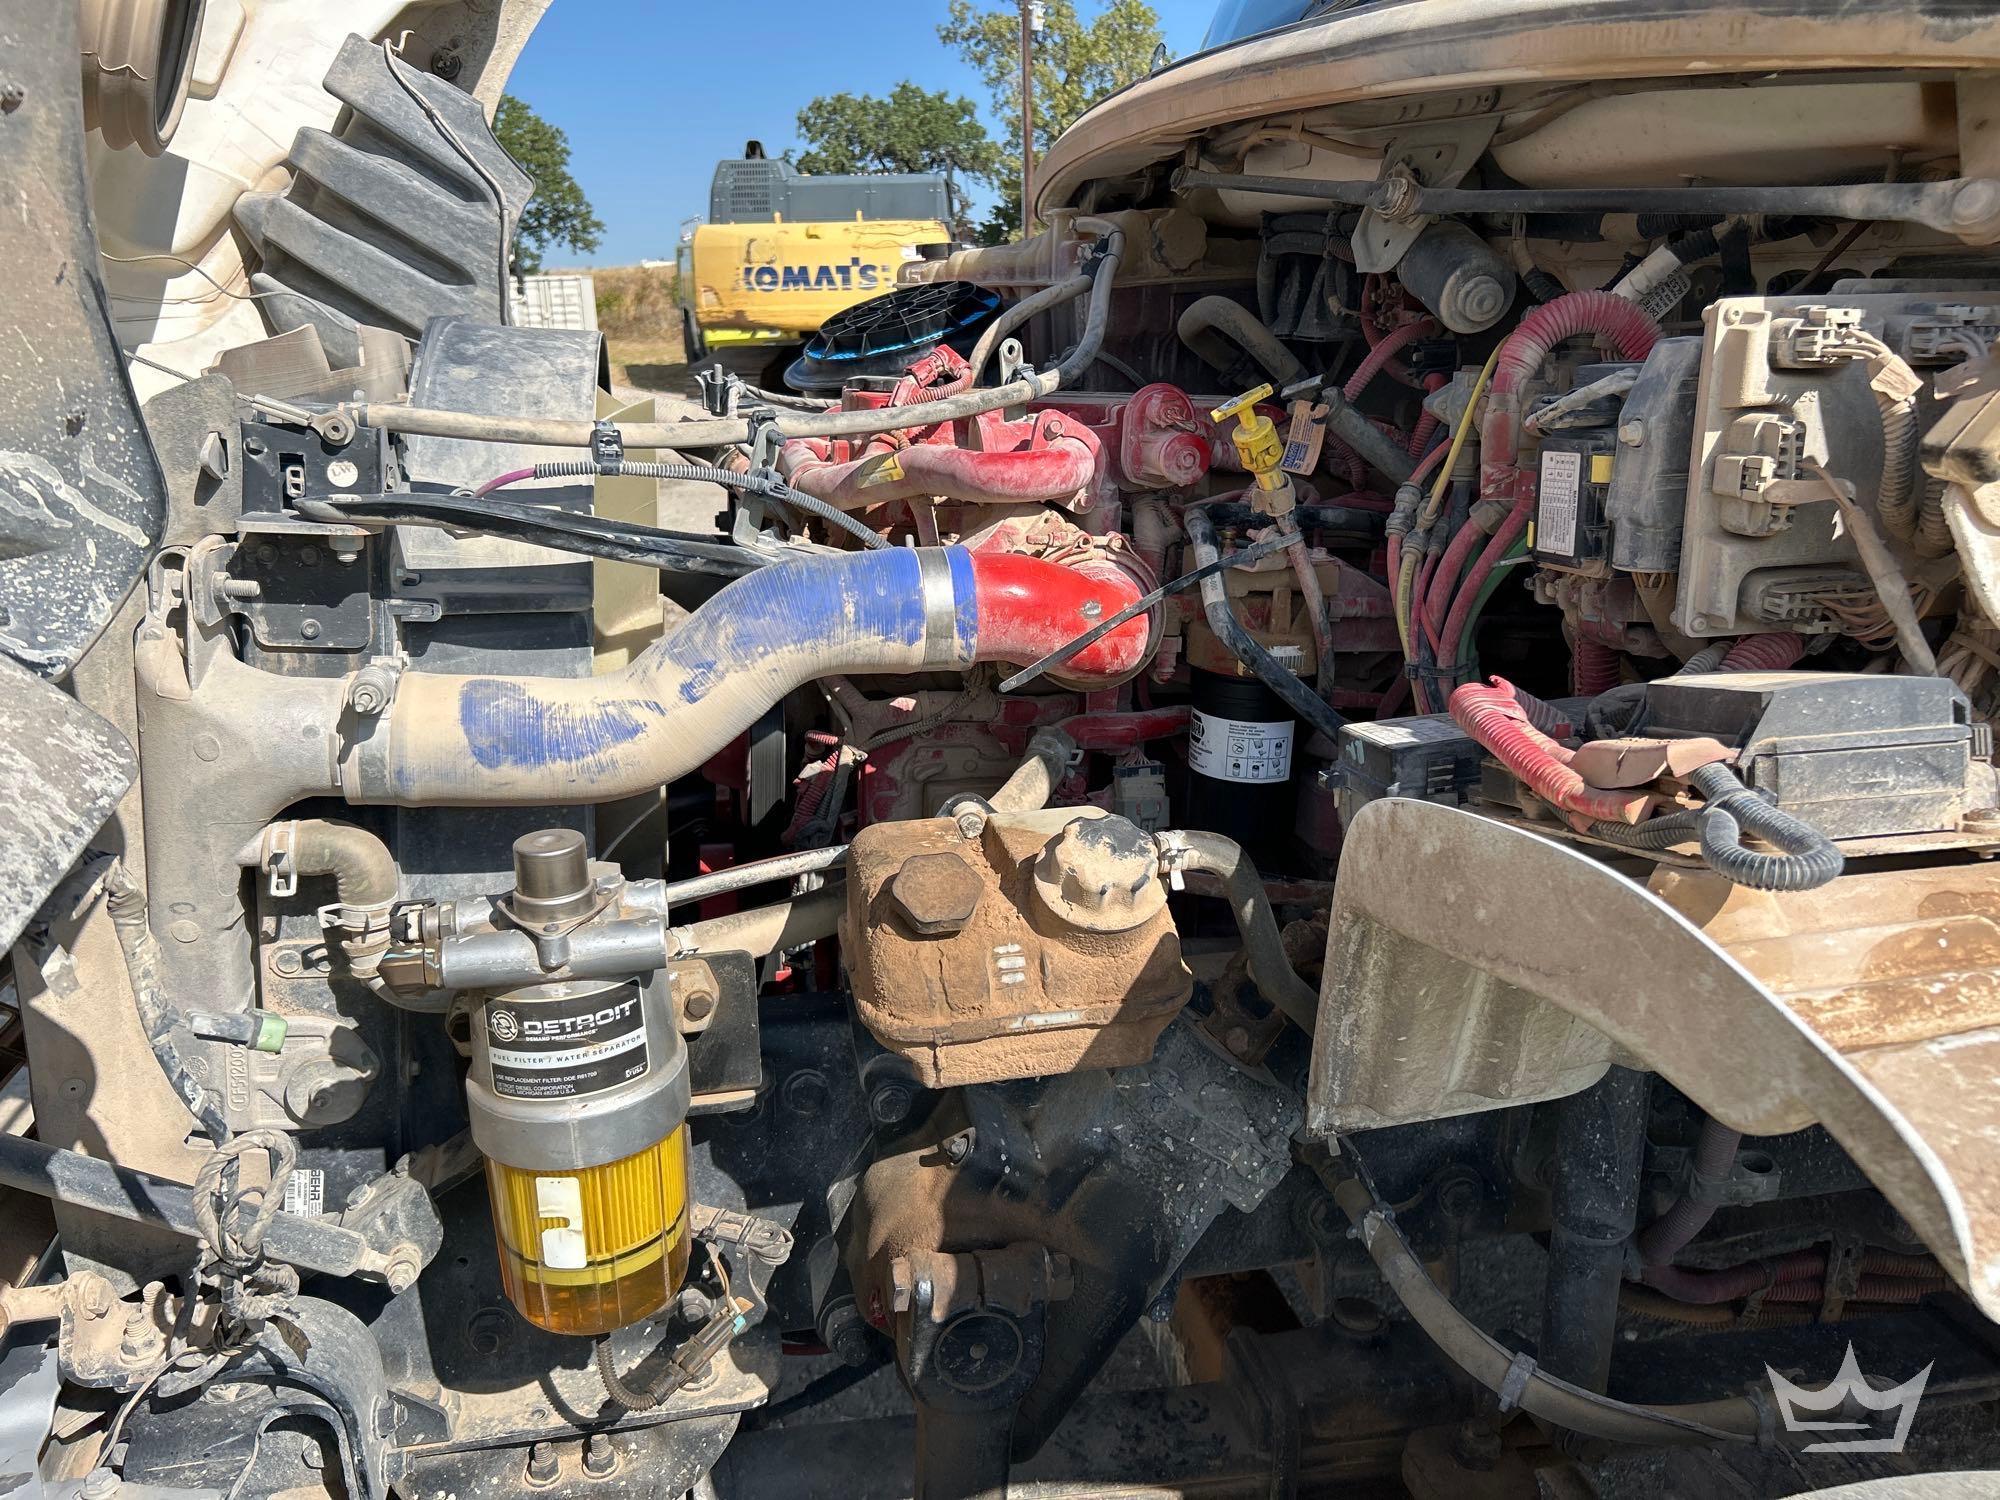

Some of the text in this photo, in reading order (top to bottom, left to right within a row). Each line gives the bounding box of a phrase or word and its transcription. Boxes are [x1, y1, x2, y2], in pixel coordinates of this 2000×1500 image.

[523, 999, 634, 1035] DETROIT
[493, 1053, 511, 1063] FUEL
[556, 1052, 588, 1063] WATER
[592, 1034, 641, 1056] SEPARATOR
[551, 1028, 597, 1042] PERFORMANCE
[504, 1075, 541, 1084] REPLACEMENT
[310, 1170, 321, 1201] BEHR
